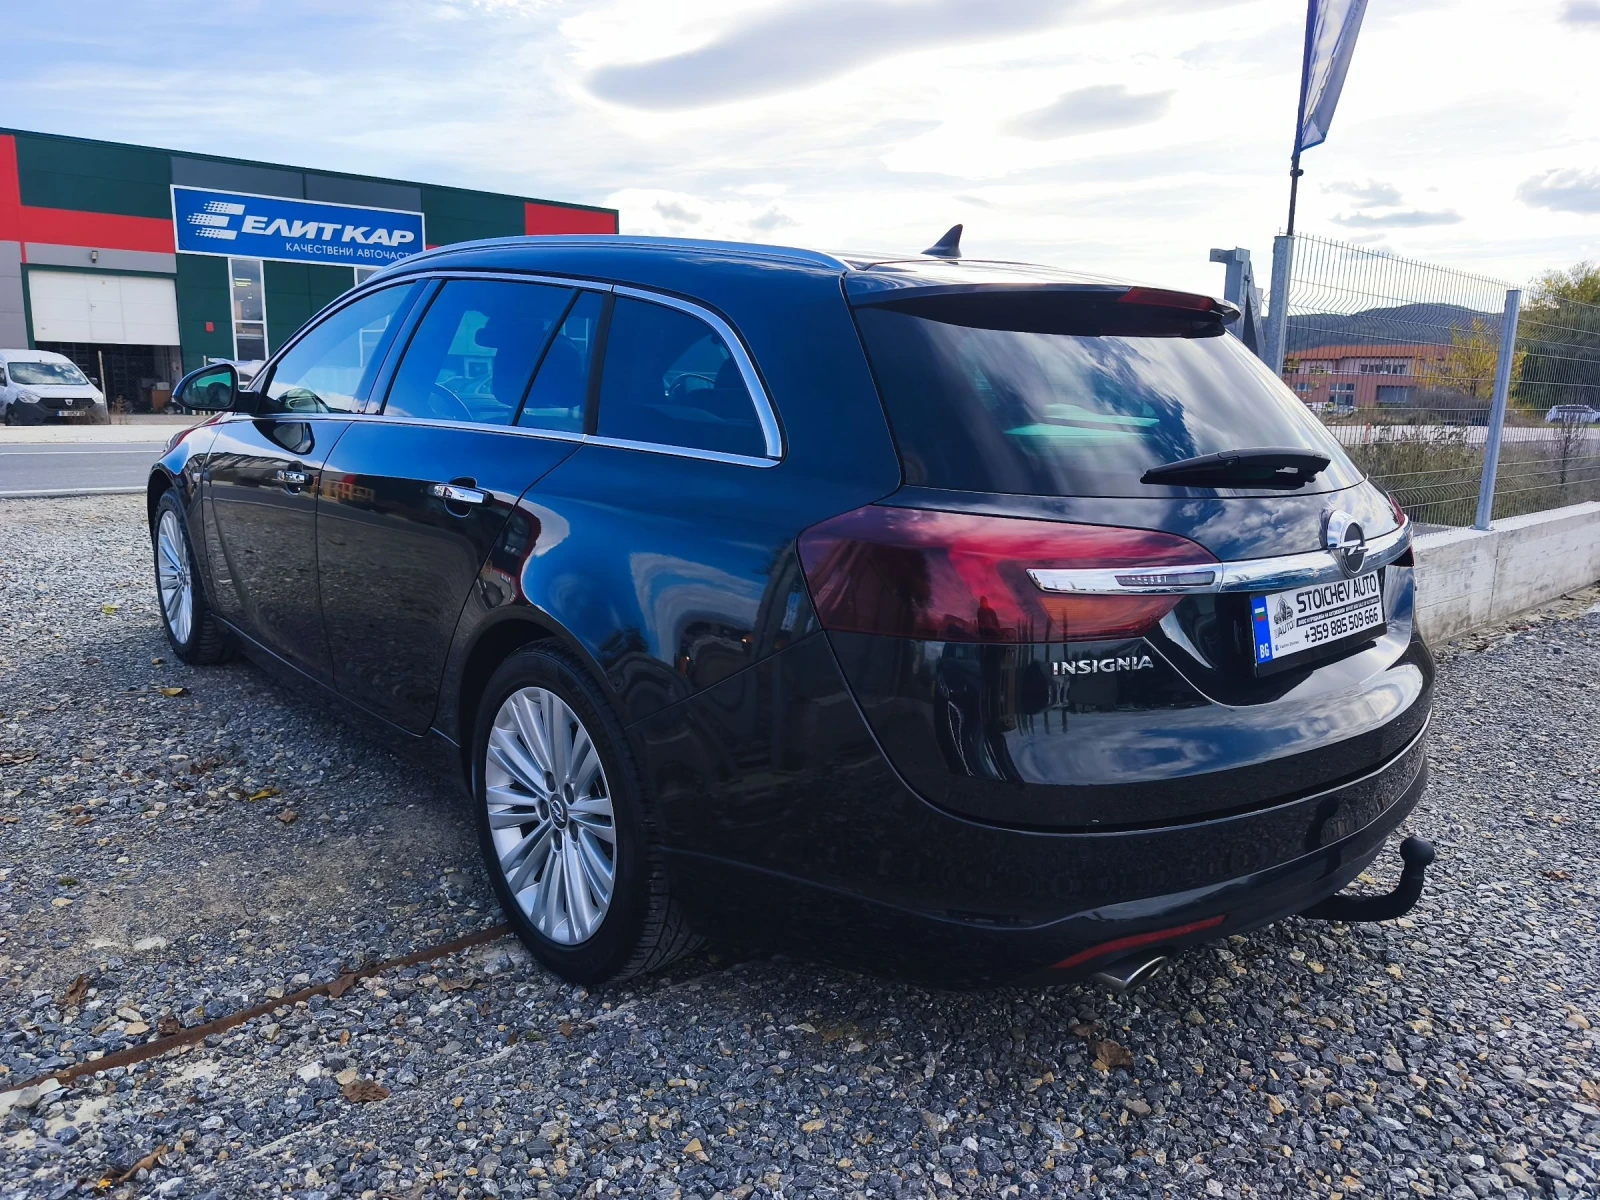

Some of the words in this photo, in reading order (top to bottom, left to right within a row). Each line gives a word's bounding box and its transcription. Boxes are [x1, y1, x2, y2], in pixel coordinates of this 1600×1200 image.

[241, 215, 342, 240] ЕЛИТ
[342, 225, 415, 247] КАР
[286, 242, 354, 257] КАЧЕСТВЕНИ
[1296, 581, 1351, 613] STOICHEV
[1353, 574, 1377, 599] AUTO
[1304, 622, 1329, 643] +359
[1331, 617, 1348, 636] 885
[1350, 611, 1363, 630] 509
[1365, 607, 1378, 625] 666
[1260, 643, 1270, 659] BG
[1052, 655, 1154, 675] INSIGNIA
